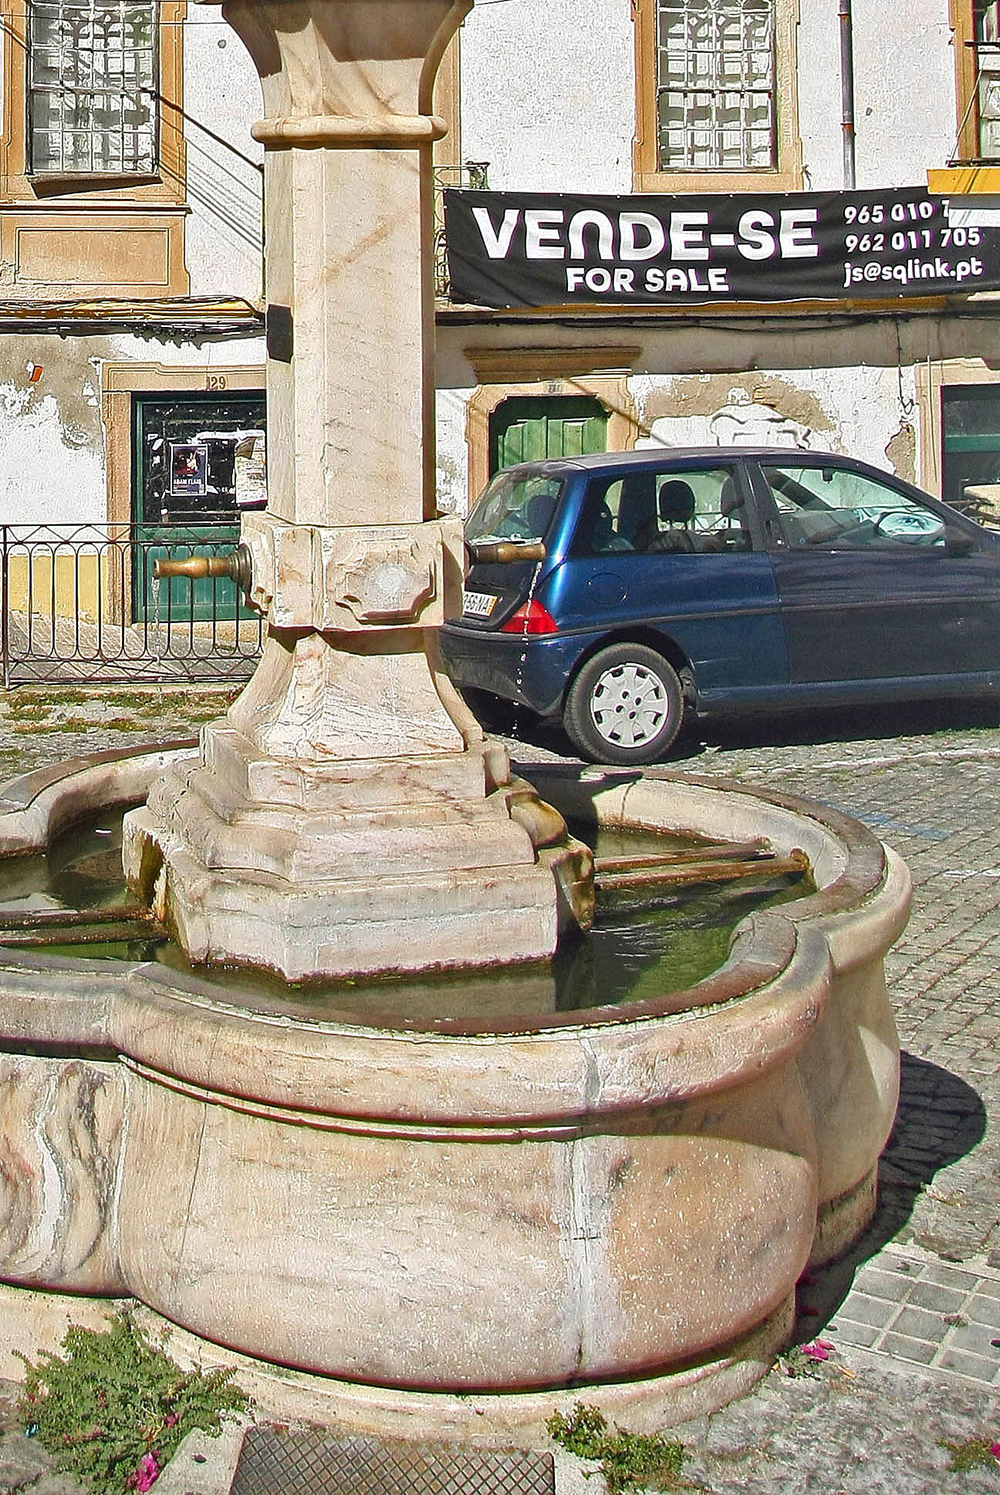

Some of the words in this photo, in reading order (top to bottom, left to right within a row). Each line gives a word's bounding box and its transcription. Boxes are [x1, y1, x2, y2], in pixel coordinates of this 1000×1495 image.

[844, 205, 884, 224] 965
[891, 201, 933, 222] 010
[471, 207, 820, 260] VENDE-SE
[845, 233, 885, 253] 962
[891, 229, 931, 251] 011
[940, 227, 981, 247] 705
[565, 267, 635, 292] FOR
[643, 267, 729, 292] SALE
[843, 257, 983, 288] js@sqlink.pt
